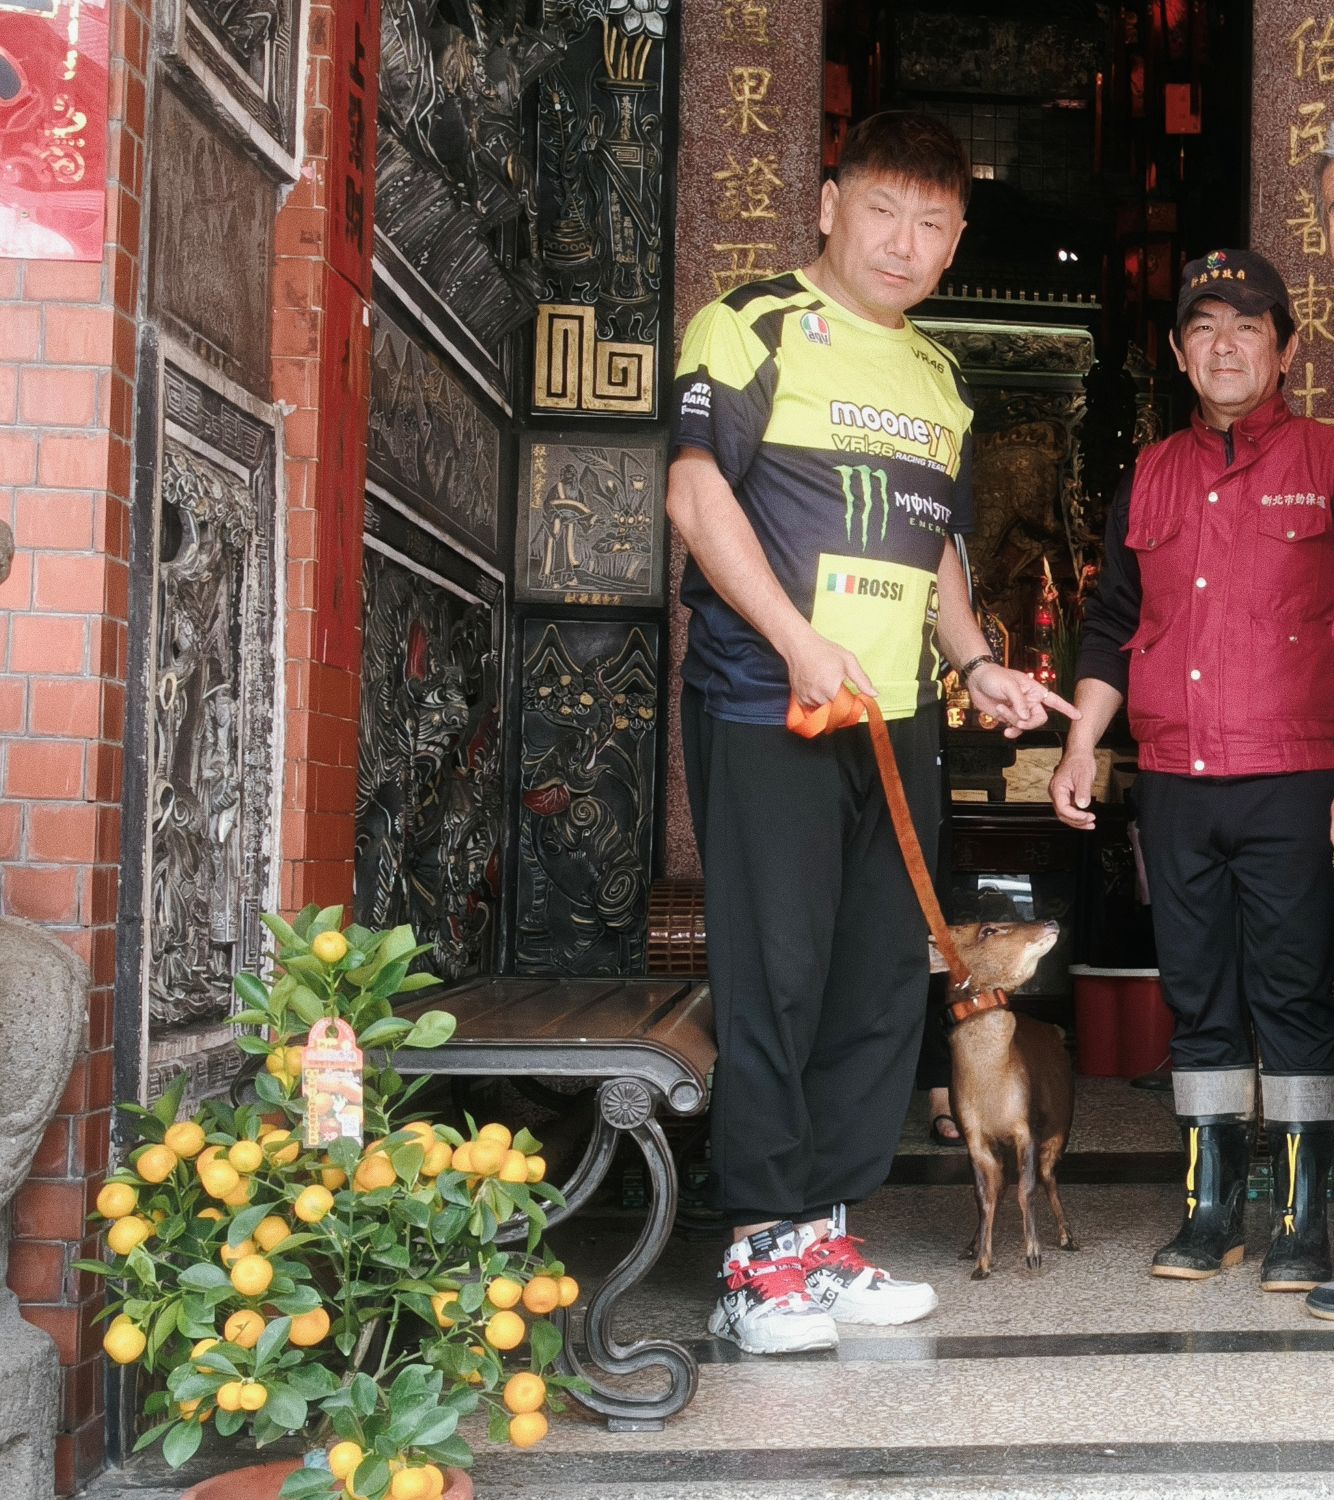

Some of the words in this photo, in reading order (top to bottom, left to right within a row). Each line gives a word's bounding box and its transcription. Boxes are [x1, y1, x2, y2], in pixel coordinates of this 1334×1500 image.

[895, 450, 926, 467] RACING
[927, 460, 947, 474] TEAM
[857, 576, 905, 602] ROSSI
